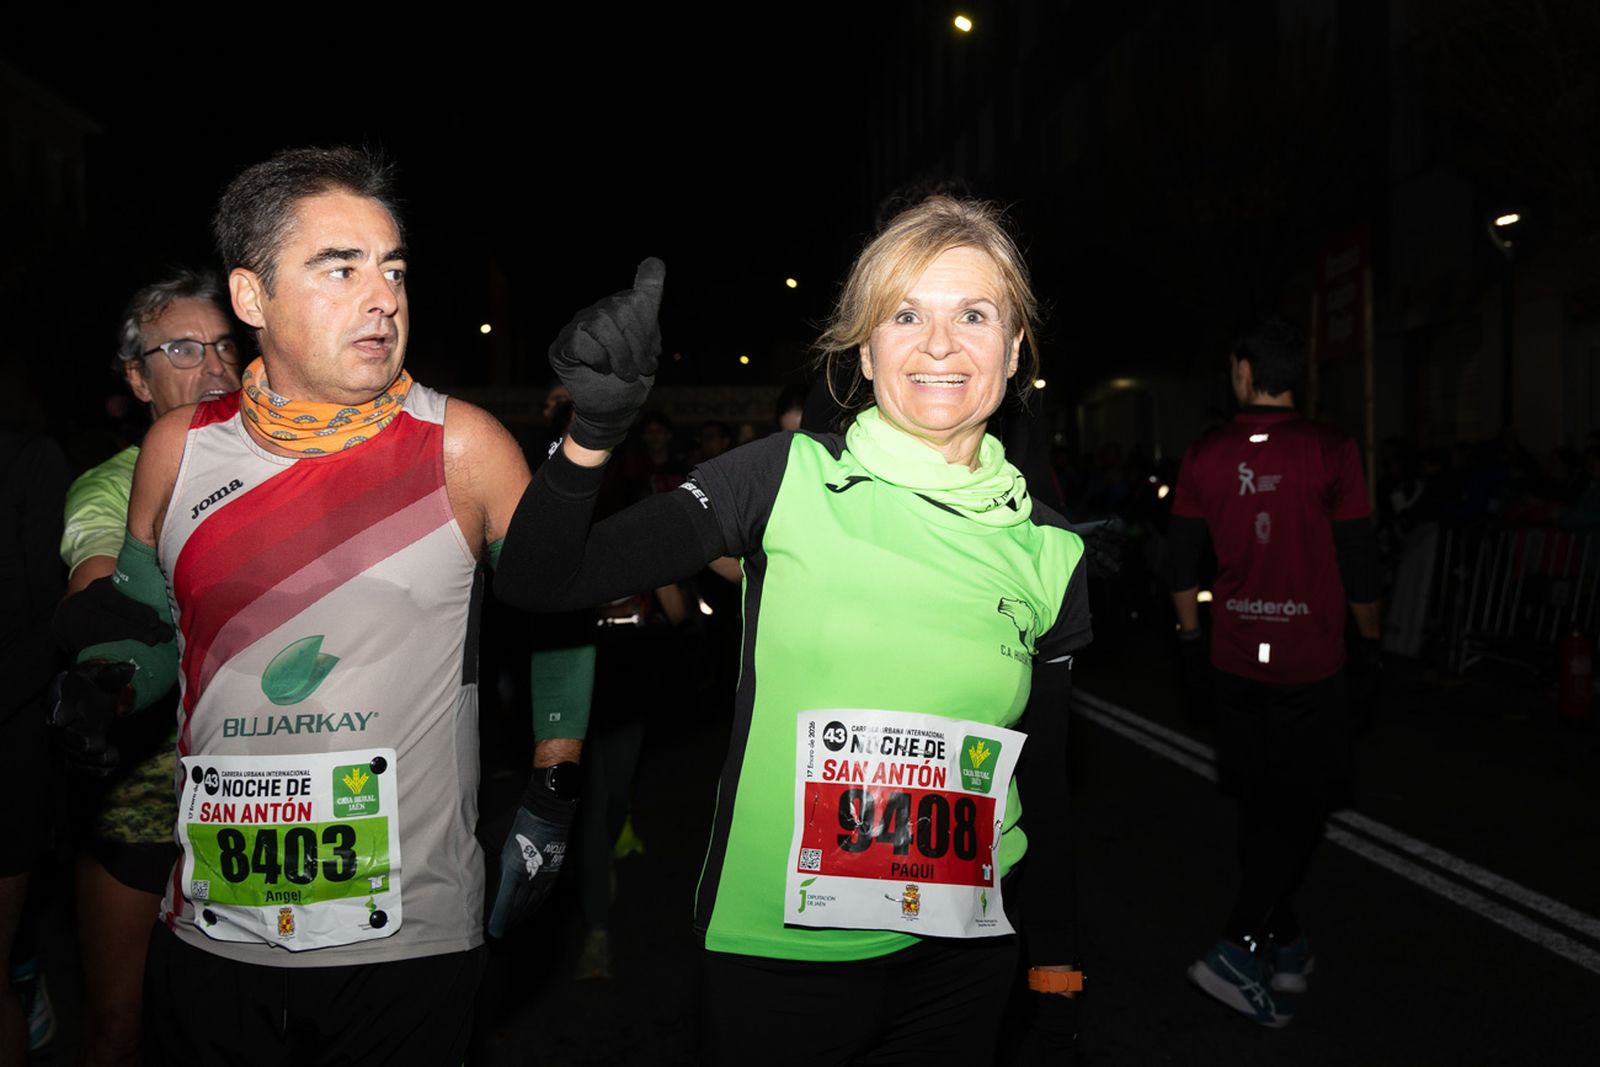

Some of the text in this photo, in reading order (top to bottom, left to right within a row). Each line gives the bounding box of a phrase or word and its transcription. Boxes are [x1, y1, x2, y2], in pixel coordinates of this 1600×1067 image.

[824, 728, 846, 743] 43
[923, 740, 946, 760] DE
[205, 774, 219, 787] 43
[822, 759, 947, 788] SAN ANTÓN
[222, 778, 311, 797] NOCHE DE
[200, 797, 313, 823] SAN ANTÓN
[837, 788, 977, 861] 9408
[217, 824, 358, 885] 8403
[890, 862, 935, 880] PAQUI
[265, 889, 301, 904] Angel
